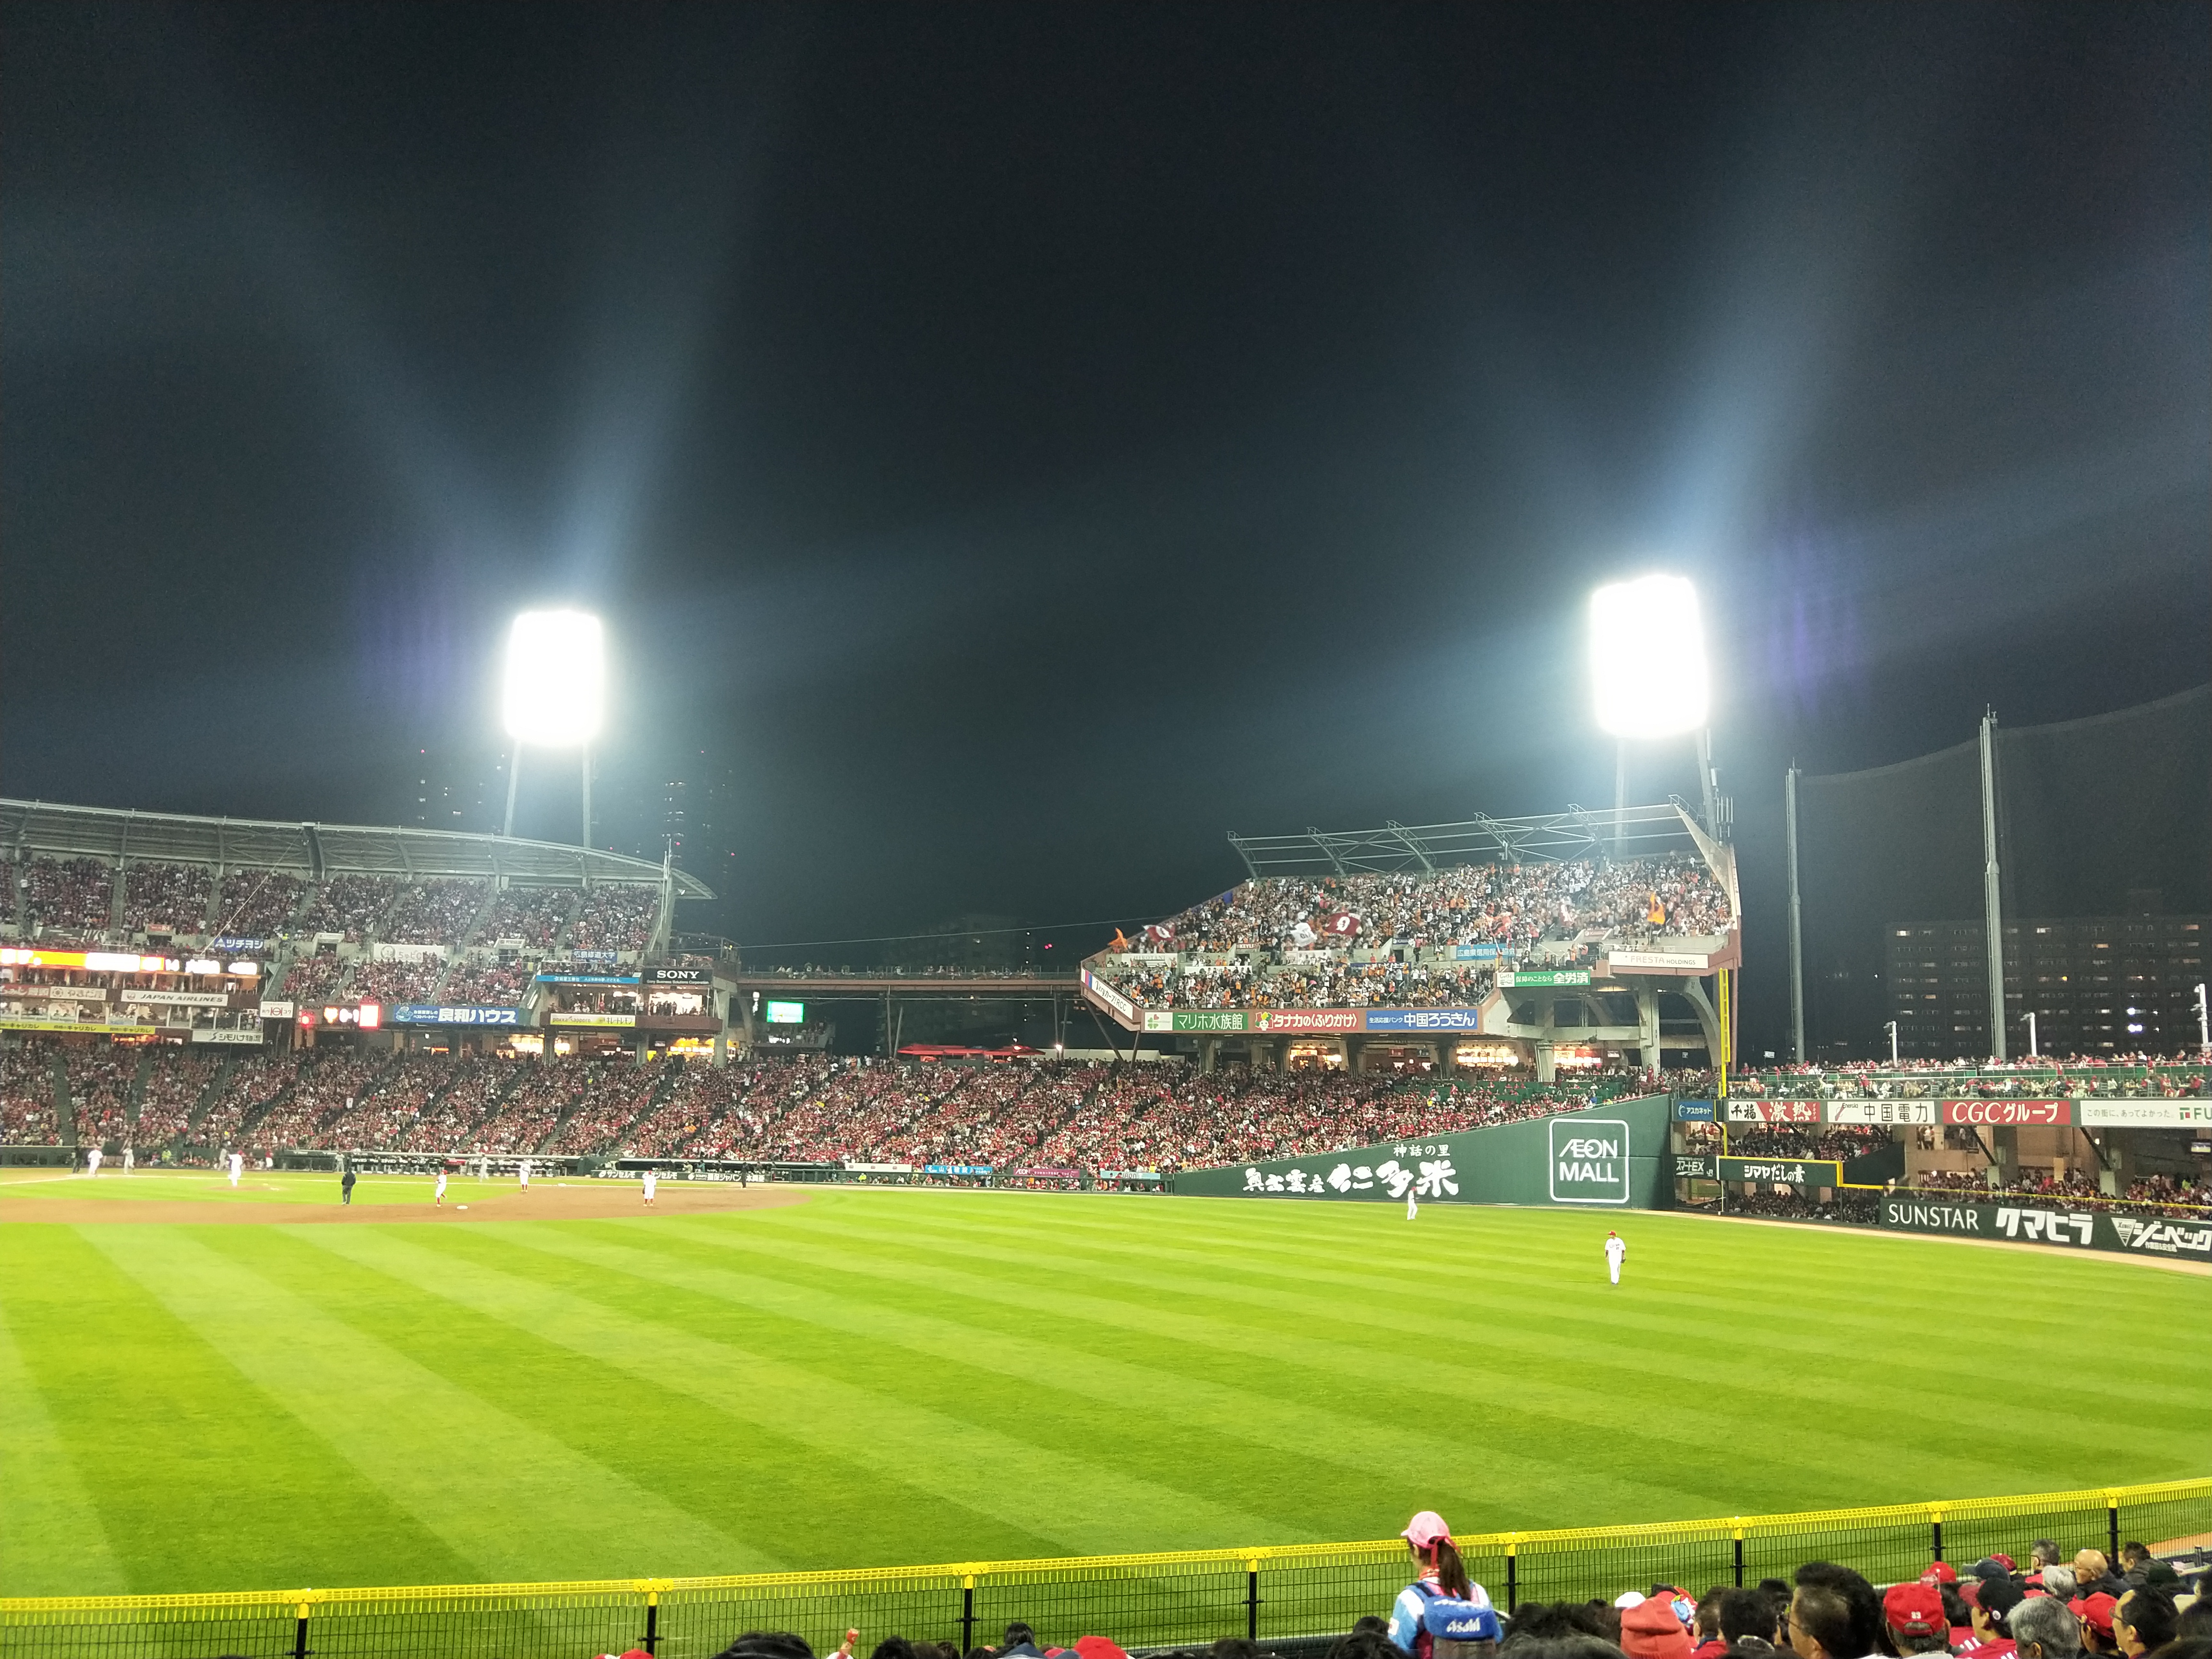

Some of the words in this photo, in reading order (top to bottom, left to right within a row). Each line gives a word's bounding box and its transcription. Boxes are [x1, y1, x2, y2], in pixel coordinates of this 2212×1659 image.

[227, 939, 263, 949] ツチヨシ
[574, 950, 615, 959] 広島修道大学
[1457, 948, 1515, 957] 広島県信用保協会
[1631, 955, 1665, 963] FRESTA
[657, 970, 699, 979] SONY
[1553, 972, 1588, 984] 全労済
[67, 989, 103, 999] やまだ屋
[438, 1008, 517, 1023] 良和ハウス
[1178, 1013, 1243, 1030] マリホ水族館
[1404, 1012, 1475, 1027] 中国ろうきん
[218, 1033, 261, 1042] シモハナ物流
[1686, 1107, 1712, 1115] アスカネット
[1731, 1104, 1757, 1119] 千福
[1768, 1102, 1812, 1121] 激熱
[1864, 1103, 1928, 1122] 中国電力
[1952, 1102, 2058, 1123] CGCグループ
[2087, 1109, 2175, 1118] この街に、あってよかった。
[1393, 1143, 1451, 1157] 神話の里
[707, 1173, 765, 1182] 損保ジャパン本興亜
[1560, 1162, 1619, 1182] MALL
[1744, 1164, 1805, 1183] シマヤだしの素
[1888, 1203, 1979, 1230] SUNSTAR
[1996, 1207, 2093, 1245] クマヒラ
[2131, 1220, 2212, 1251] ジーベック
[1446, 1617, 1481, 1633] Asahi
